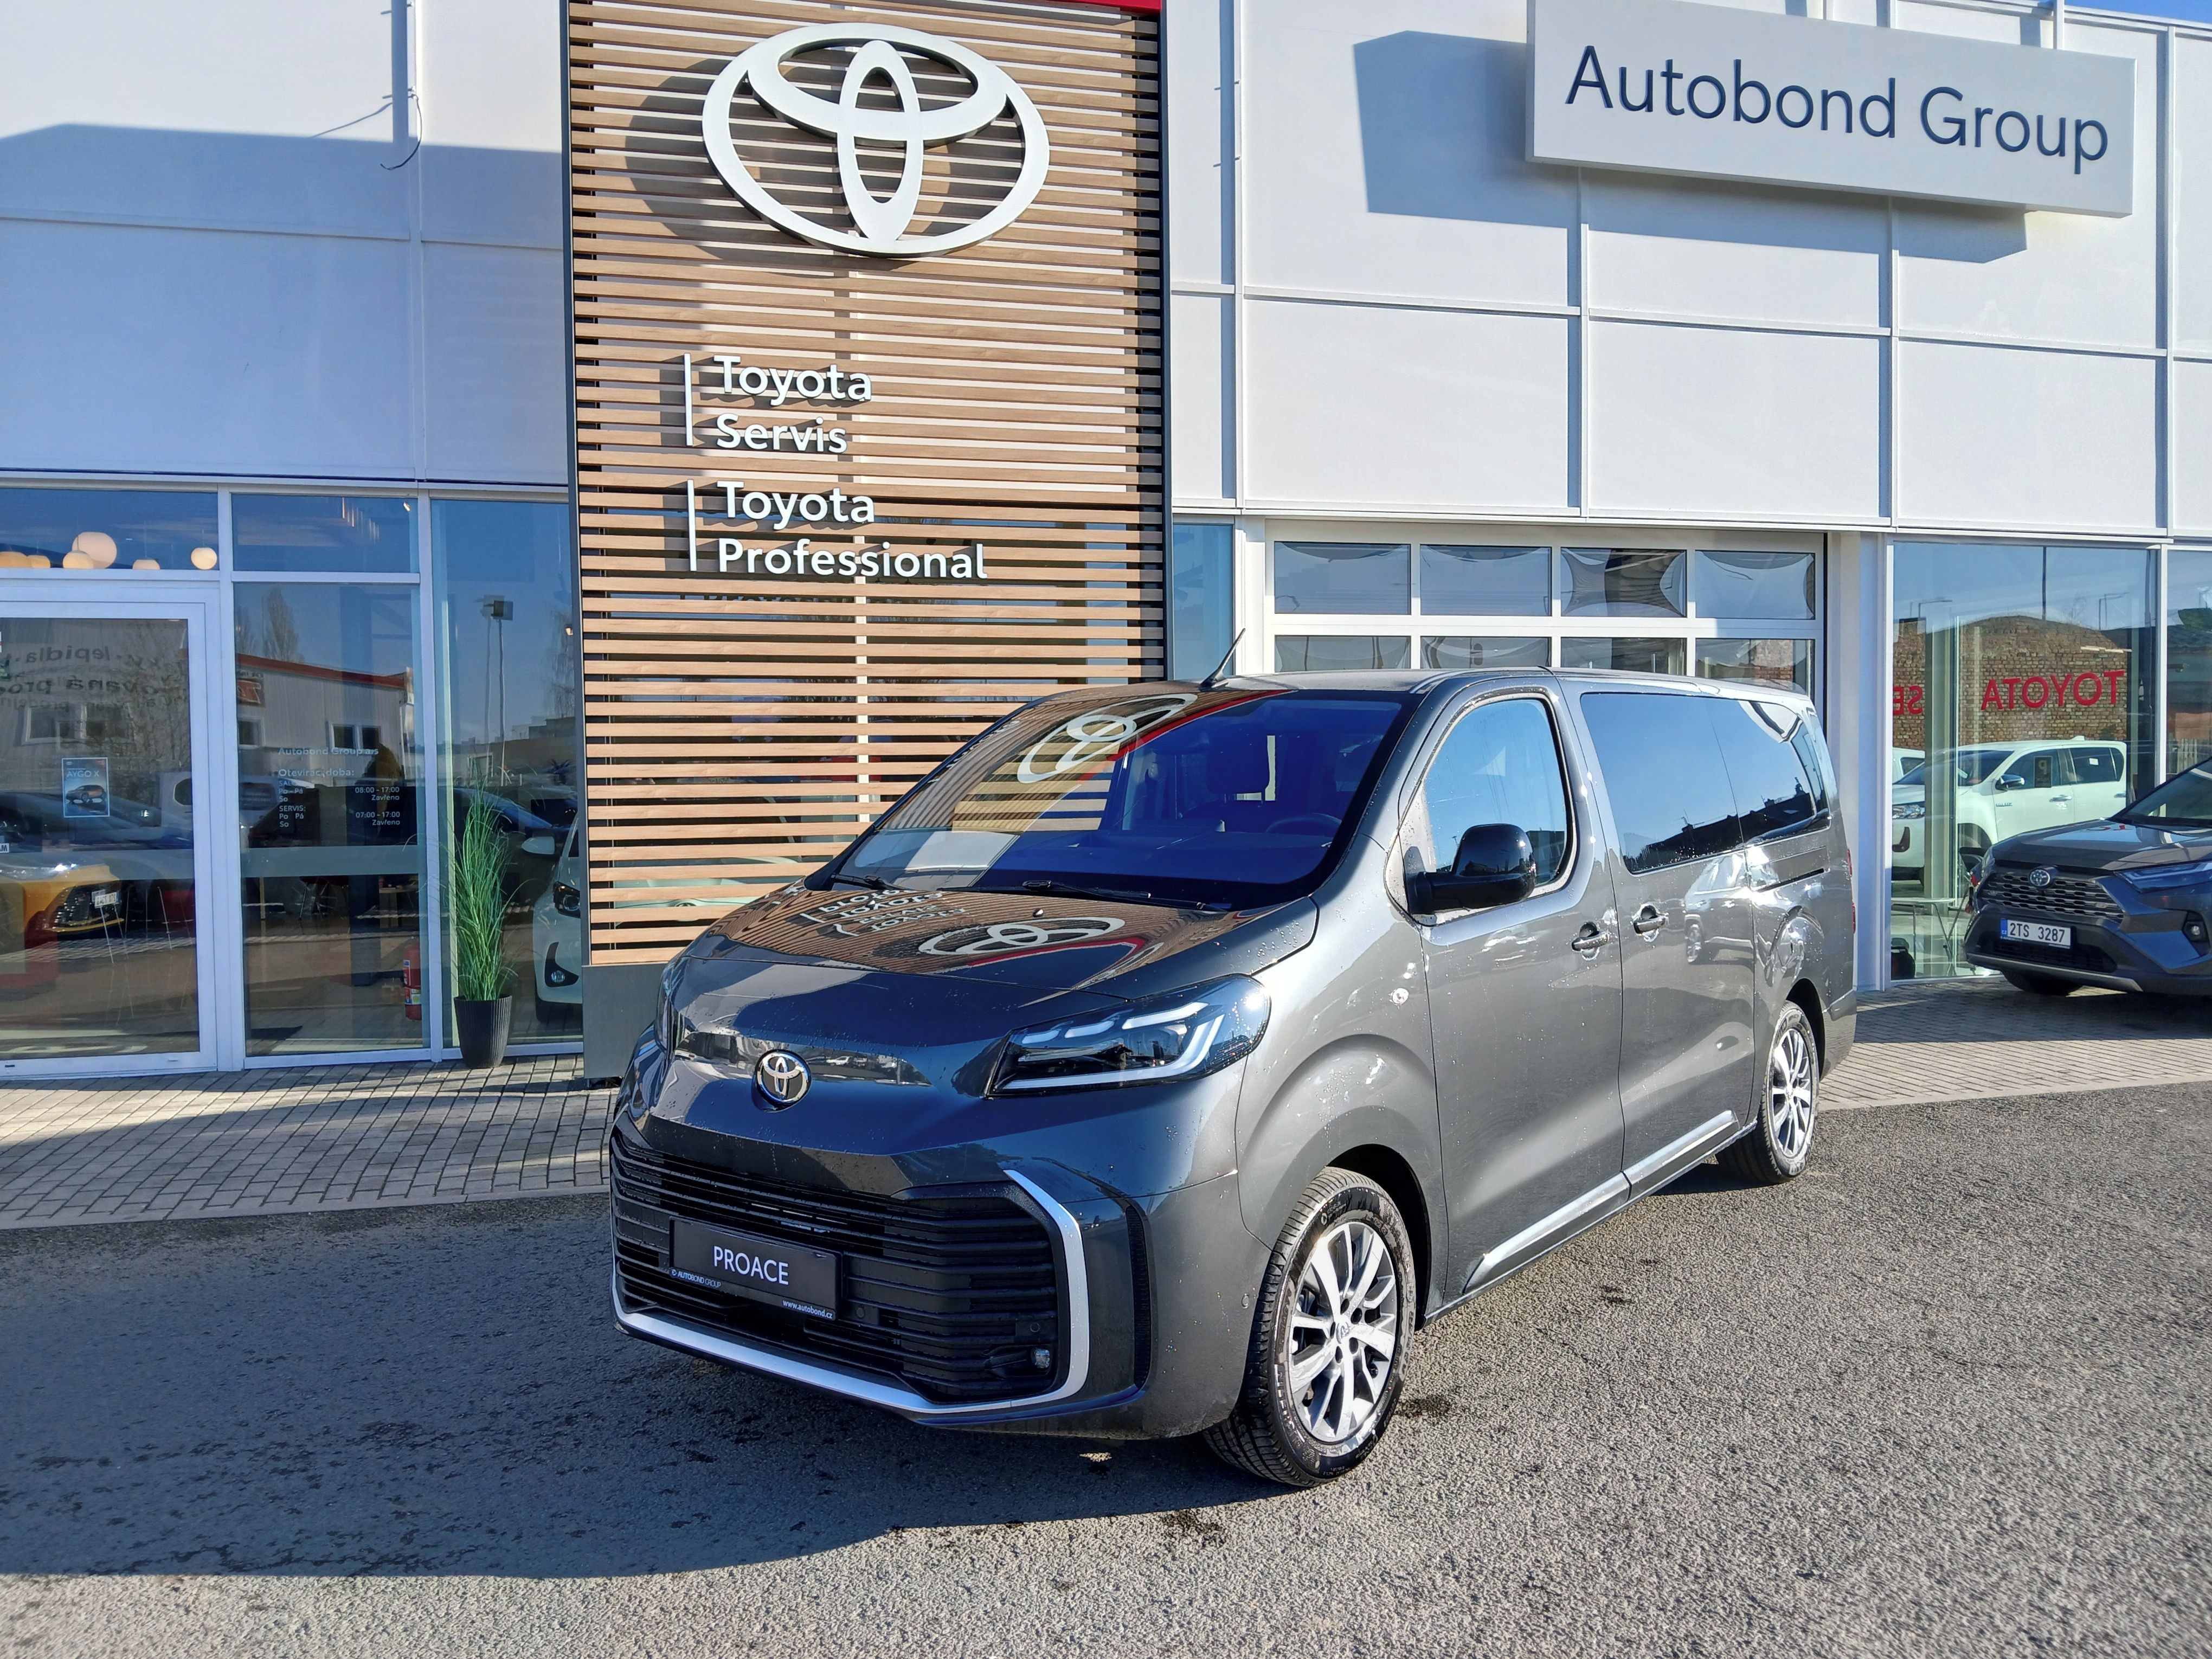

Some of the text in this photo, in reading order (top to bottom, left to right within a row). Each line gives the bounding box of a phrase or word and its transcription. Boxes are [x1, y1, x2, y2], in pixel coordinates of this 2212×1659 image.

[1565, 45, 2109, 175] Autobond Group
[713, 355, 872, 407] Toyota
[716, 413, 848, 454] Servis
[717, 480, 876, 531] Toyota
[718, 537, 988, 578] Professional
[278, 747, 328, 755] Autobond
[331, 747, 363, 756] Group
[325, 768, 355, 776] doba:
[2010, 922, 2029, 937] 2TS
[2038, 927, 2065, 943] 3287
[678, 1270, 722, 1288] AUTOBOND GROUP
[713, 1245, 789, 1285] PROACE
[782, 1300, 833, 1319] www.autobond.cz
